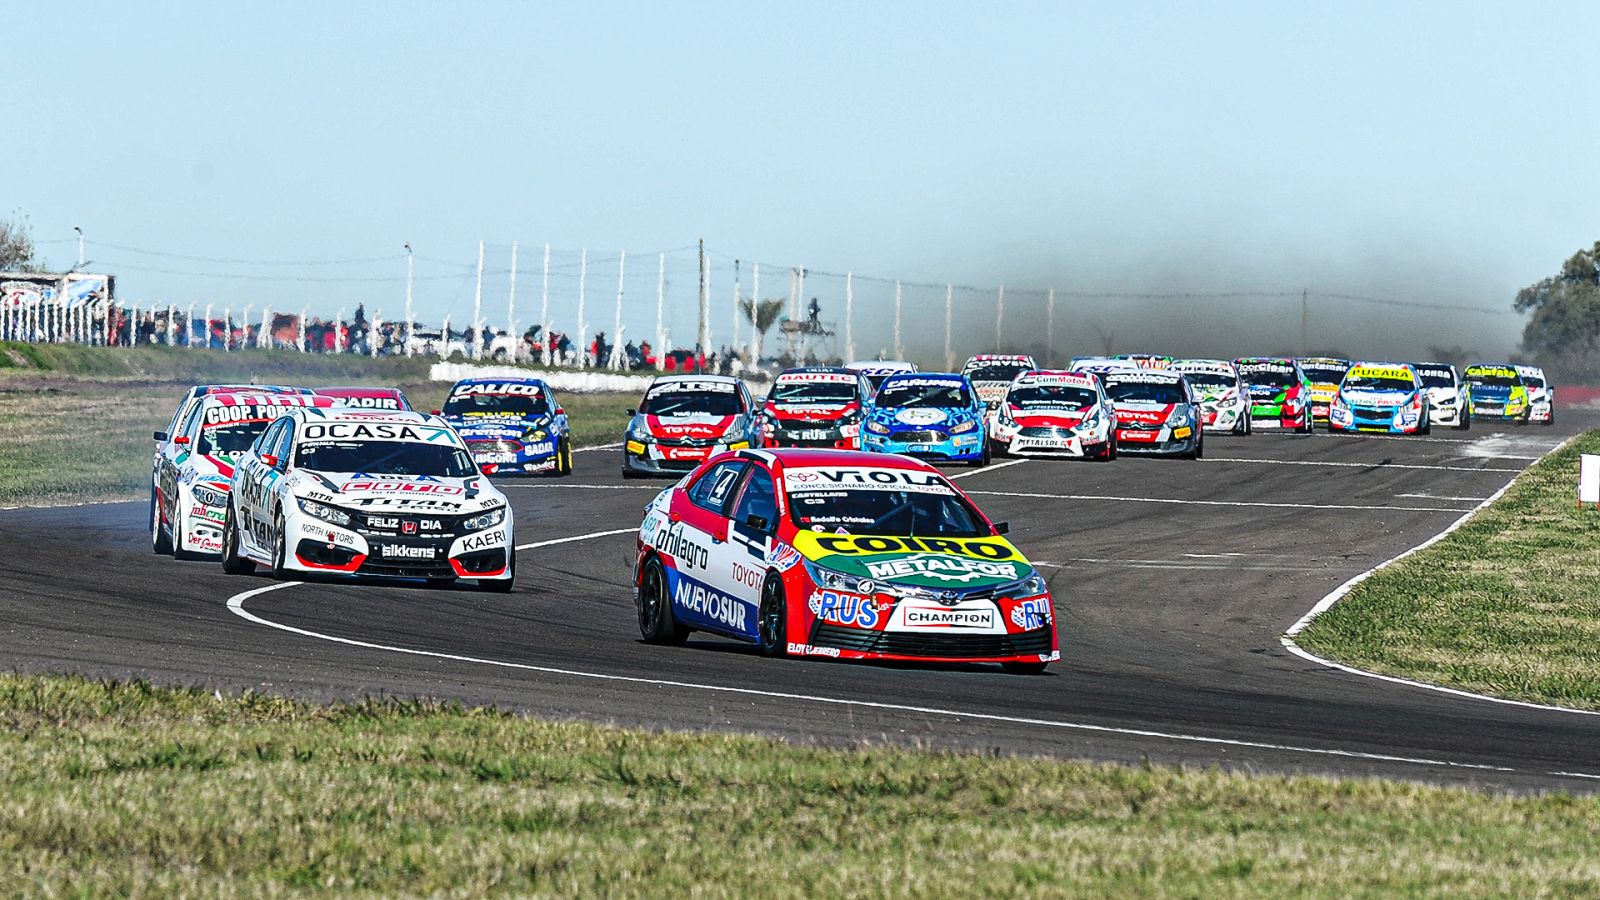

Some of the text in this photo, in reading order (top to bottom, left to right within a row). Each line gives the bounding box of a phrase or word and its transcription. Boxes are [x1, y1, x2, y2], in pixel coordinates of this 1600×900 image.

[206, 406, 254, 424] COOP.
[1115, 412, 1159, 421] TOTAL
[304, 424, 422, 441] OCASA
[662, 426, 713, 435] TOTAL
[342, 482, 463, 495] COTO
[714, 472, 734, 498] 4
[307, 491, 333, 502] MTR
[352, 498, 462, 509] TITAN
[302, 523, 324, 537] NORTH
[367, 517, 442, 529] FELIZ DIA
[462, 530, 507, 552] KAERI
[816, 536, 1013, 559] COIRO
[382, 544, 436, 559] sikkens
[865, 558, 1018, 579] METALFOR
[818, 591, 879, 629] RUS
[907, 611, 992, 623] CHAMPION
